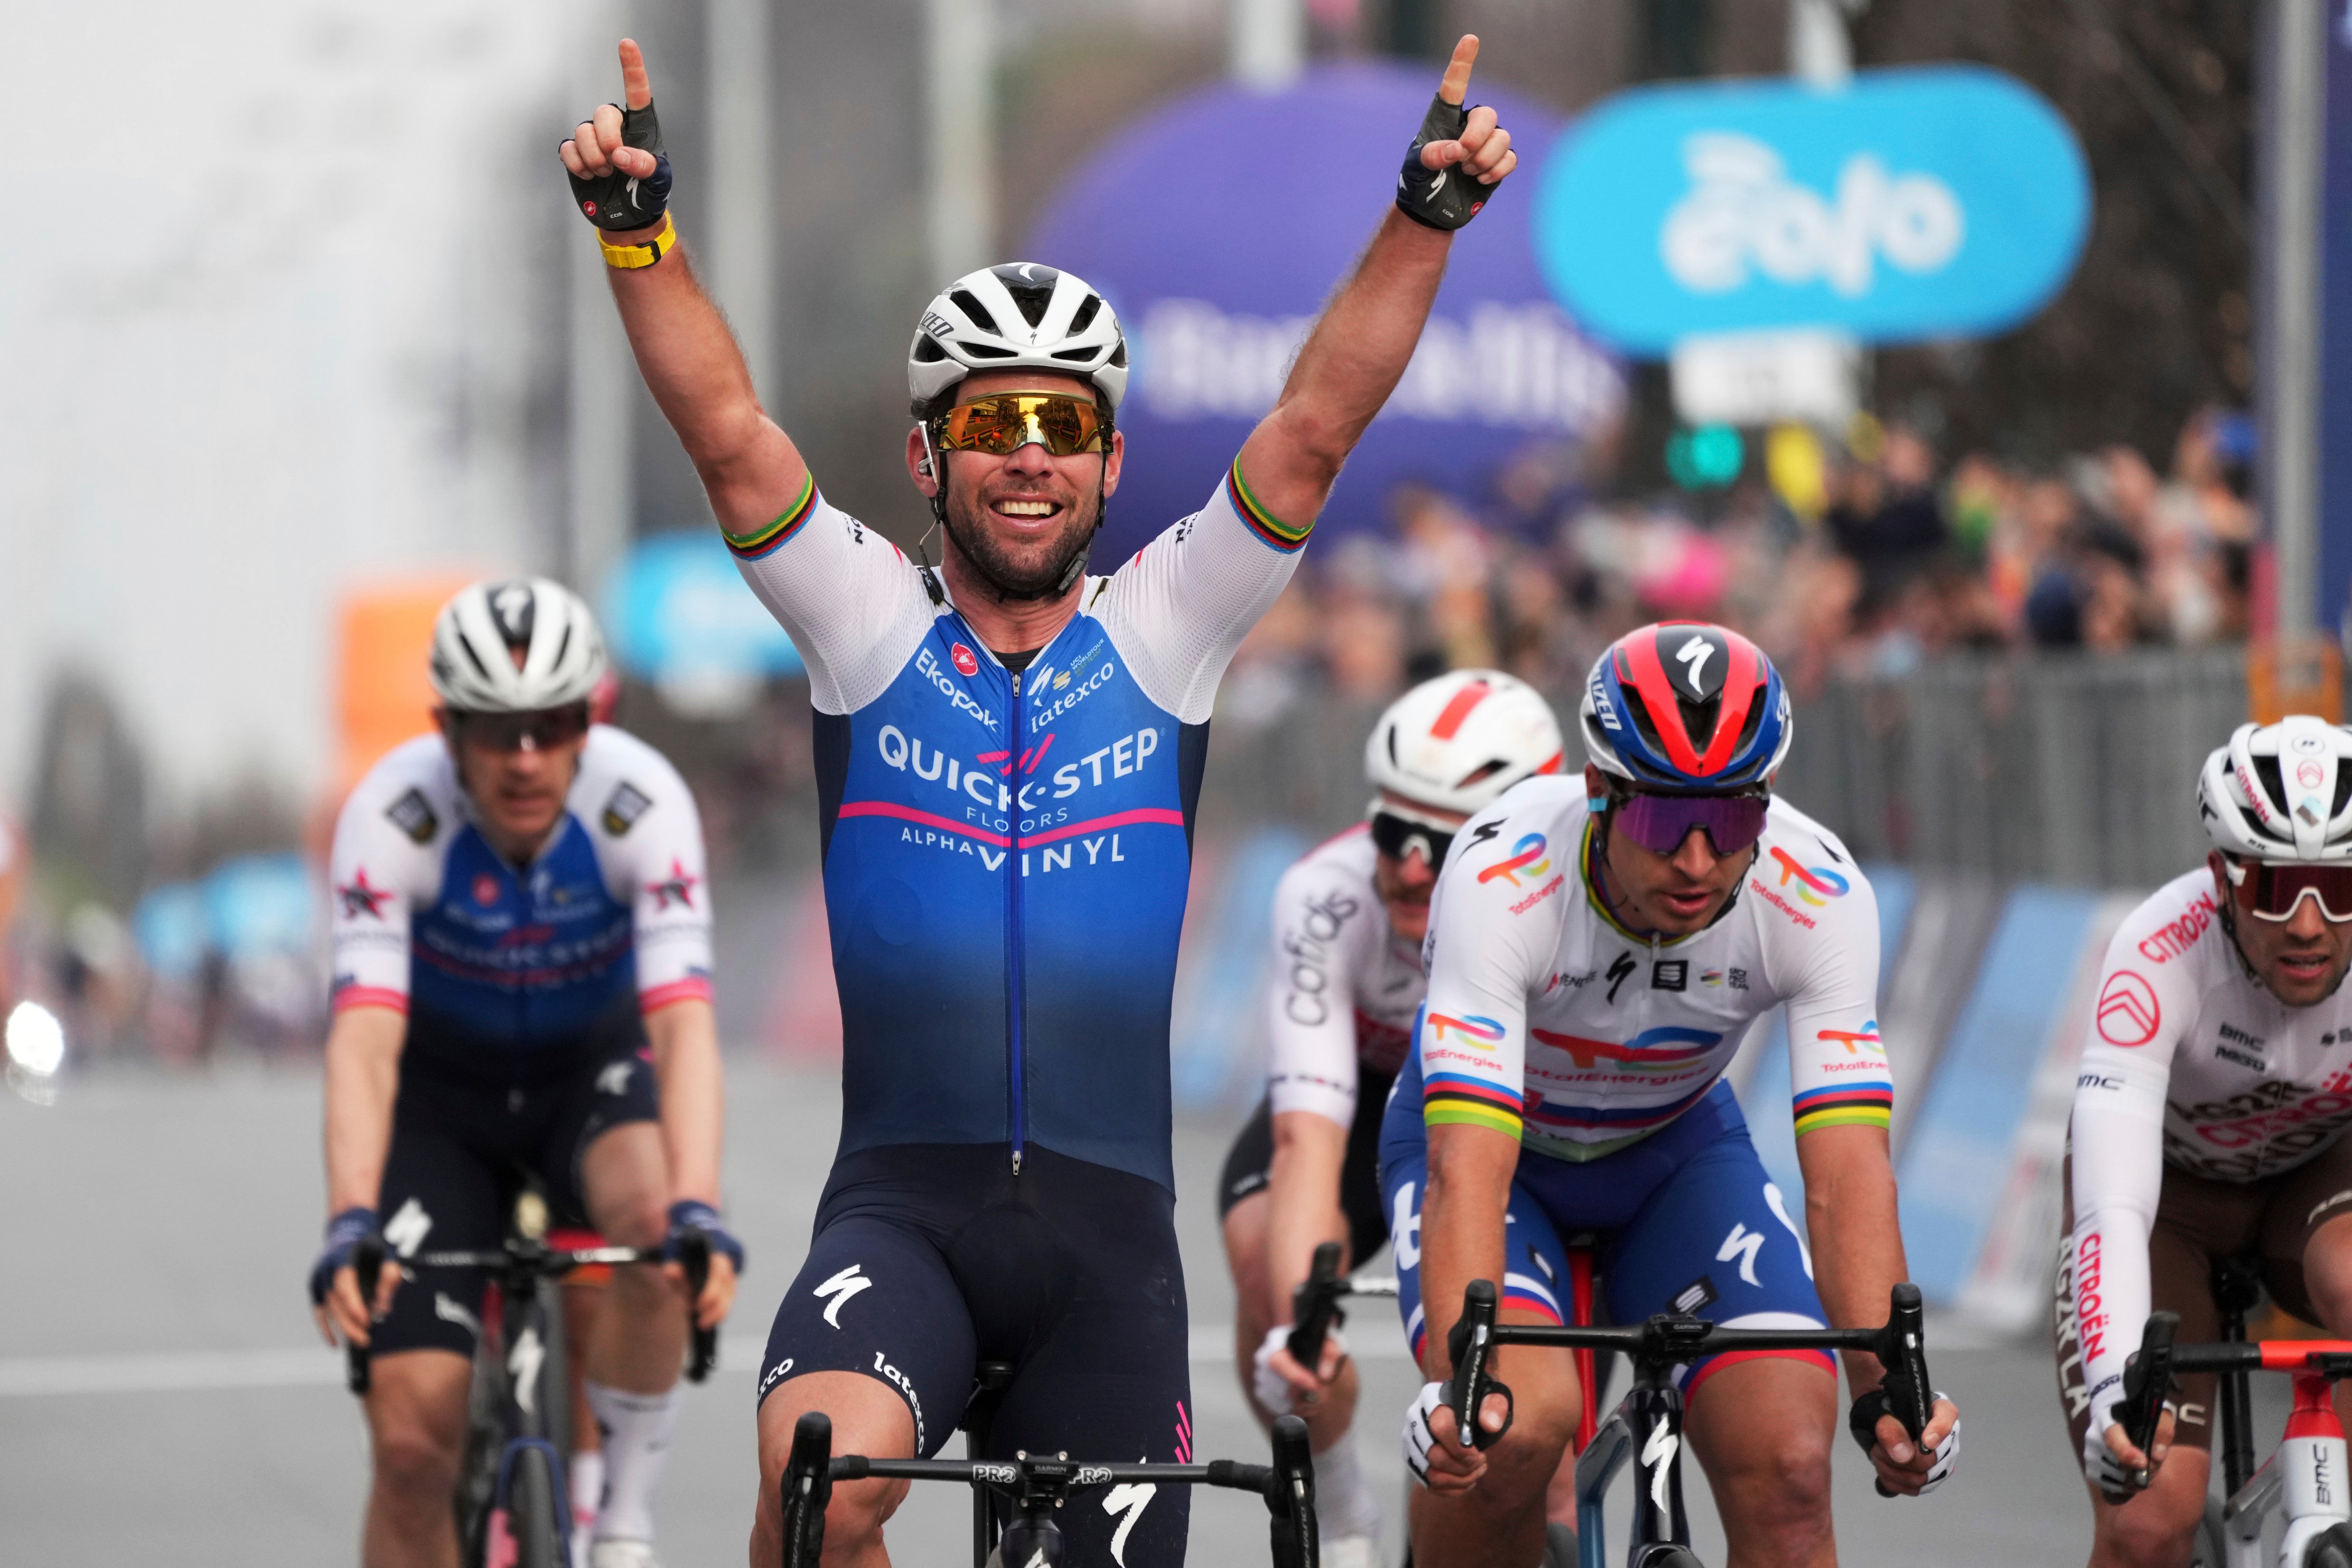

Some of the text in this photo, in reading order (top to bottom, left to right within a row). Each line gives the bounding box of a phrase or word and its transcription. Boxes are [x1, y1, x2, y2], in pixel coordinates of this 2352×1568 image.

[1070, 655, 1081, 666] UCI
[1072, 638, 1104, 670] WORLDTOUR
[915, 647, 999, 733] Ekopak
[1031, 662, 1114, 733] latexco
[966, 807, 1067, 833] FLOORS
[901, 827, 1124, 877] ALPHA VINYL
[1751, 877, 1816, 930] TotalEnergies
[2078, 1233, 2109, 1365] CITROËN
[874, 1351, 924, 1455] latexco
[973, 1464, 1017, 1484] PRO
